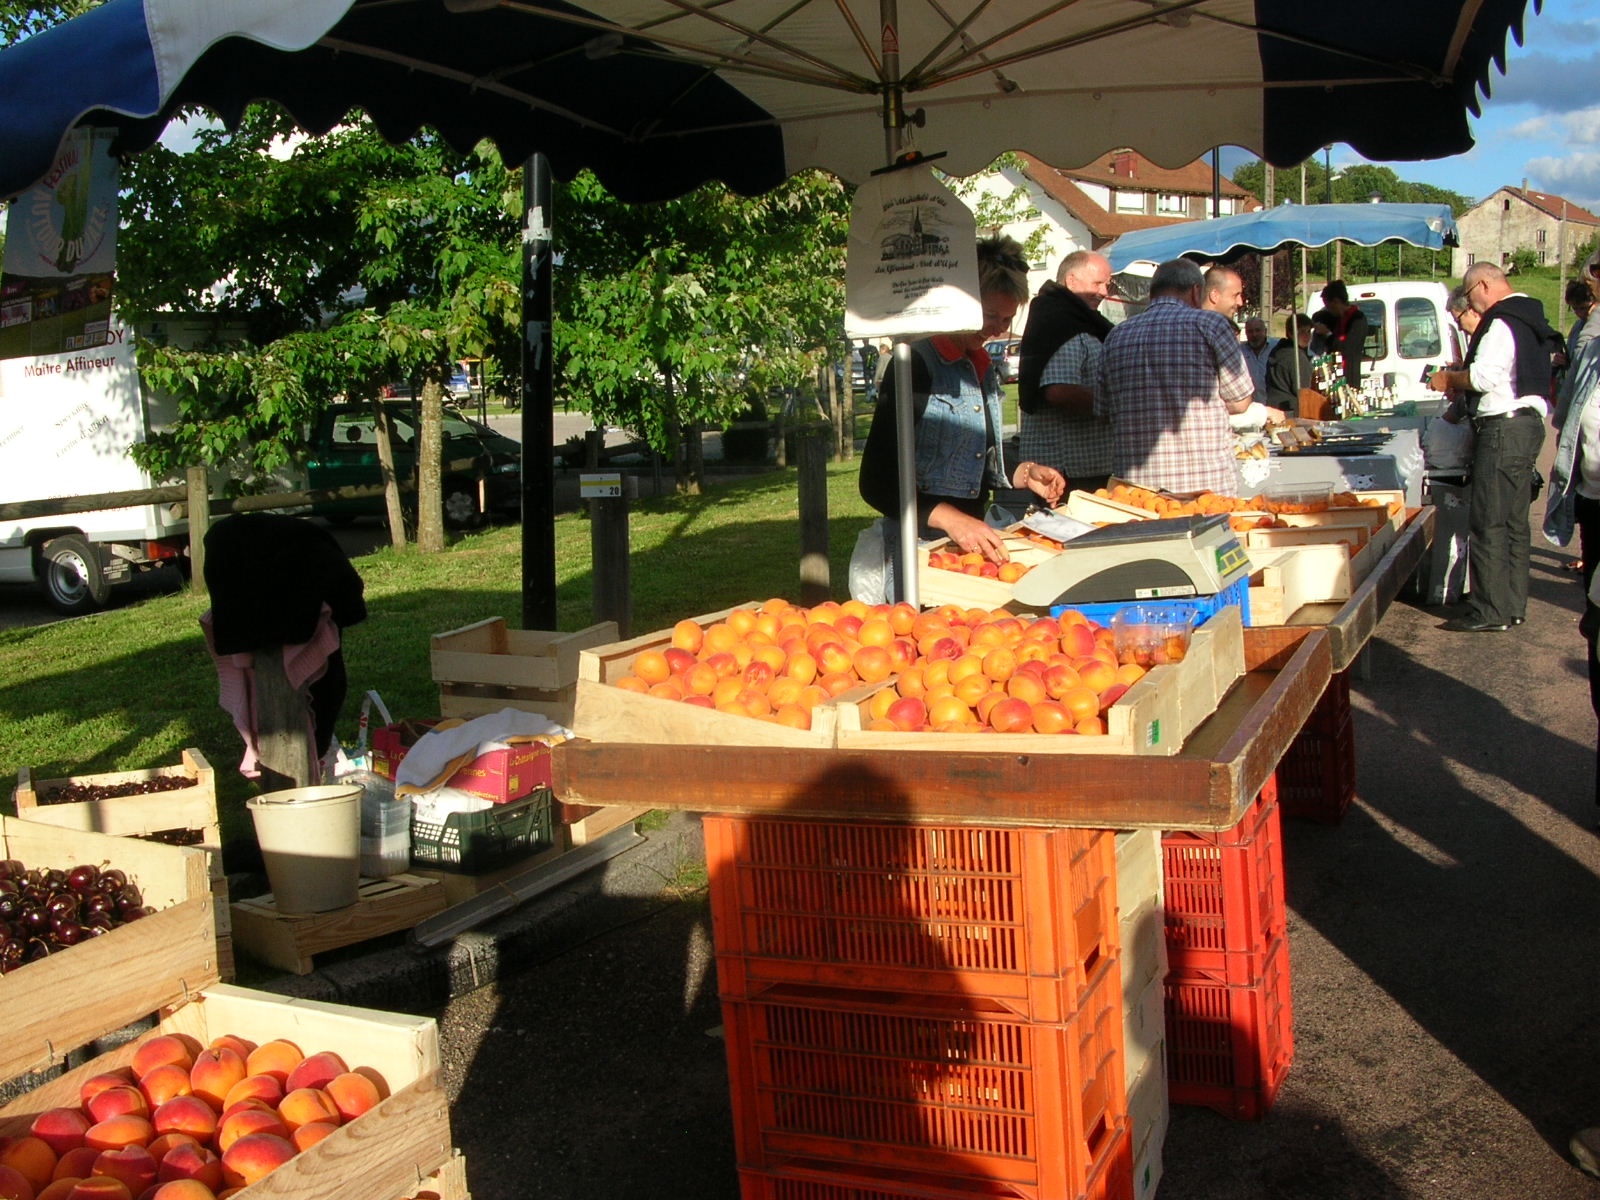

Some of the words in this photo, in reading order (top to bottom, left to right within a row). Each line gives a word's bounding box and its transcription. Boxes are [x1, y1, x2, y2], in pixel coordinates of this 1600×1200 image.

[24, 362, 61, 378] Maître
[66, 355, 116, 372] Affineur
[610, 486, 620, 496] 20
